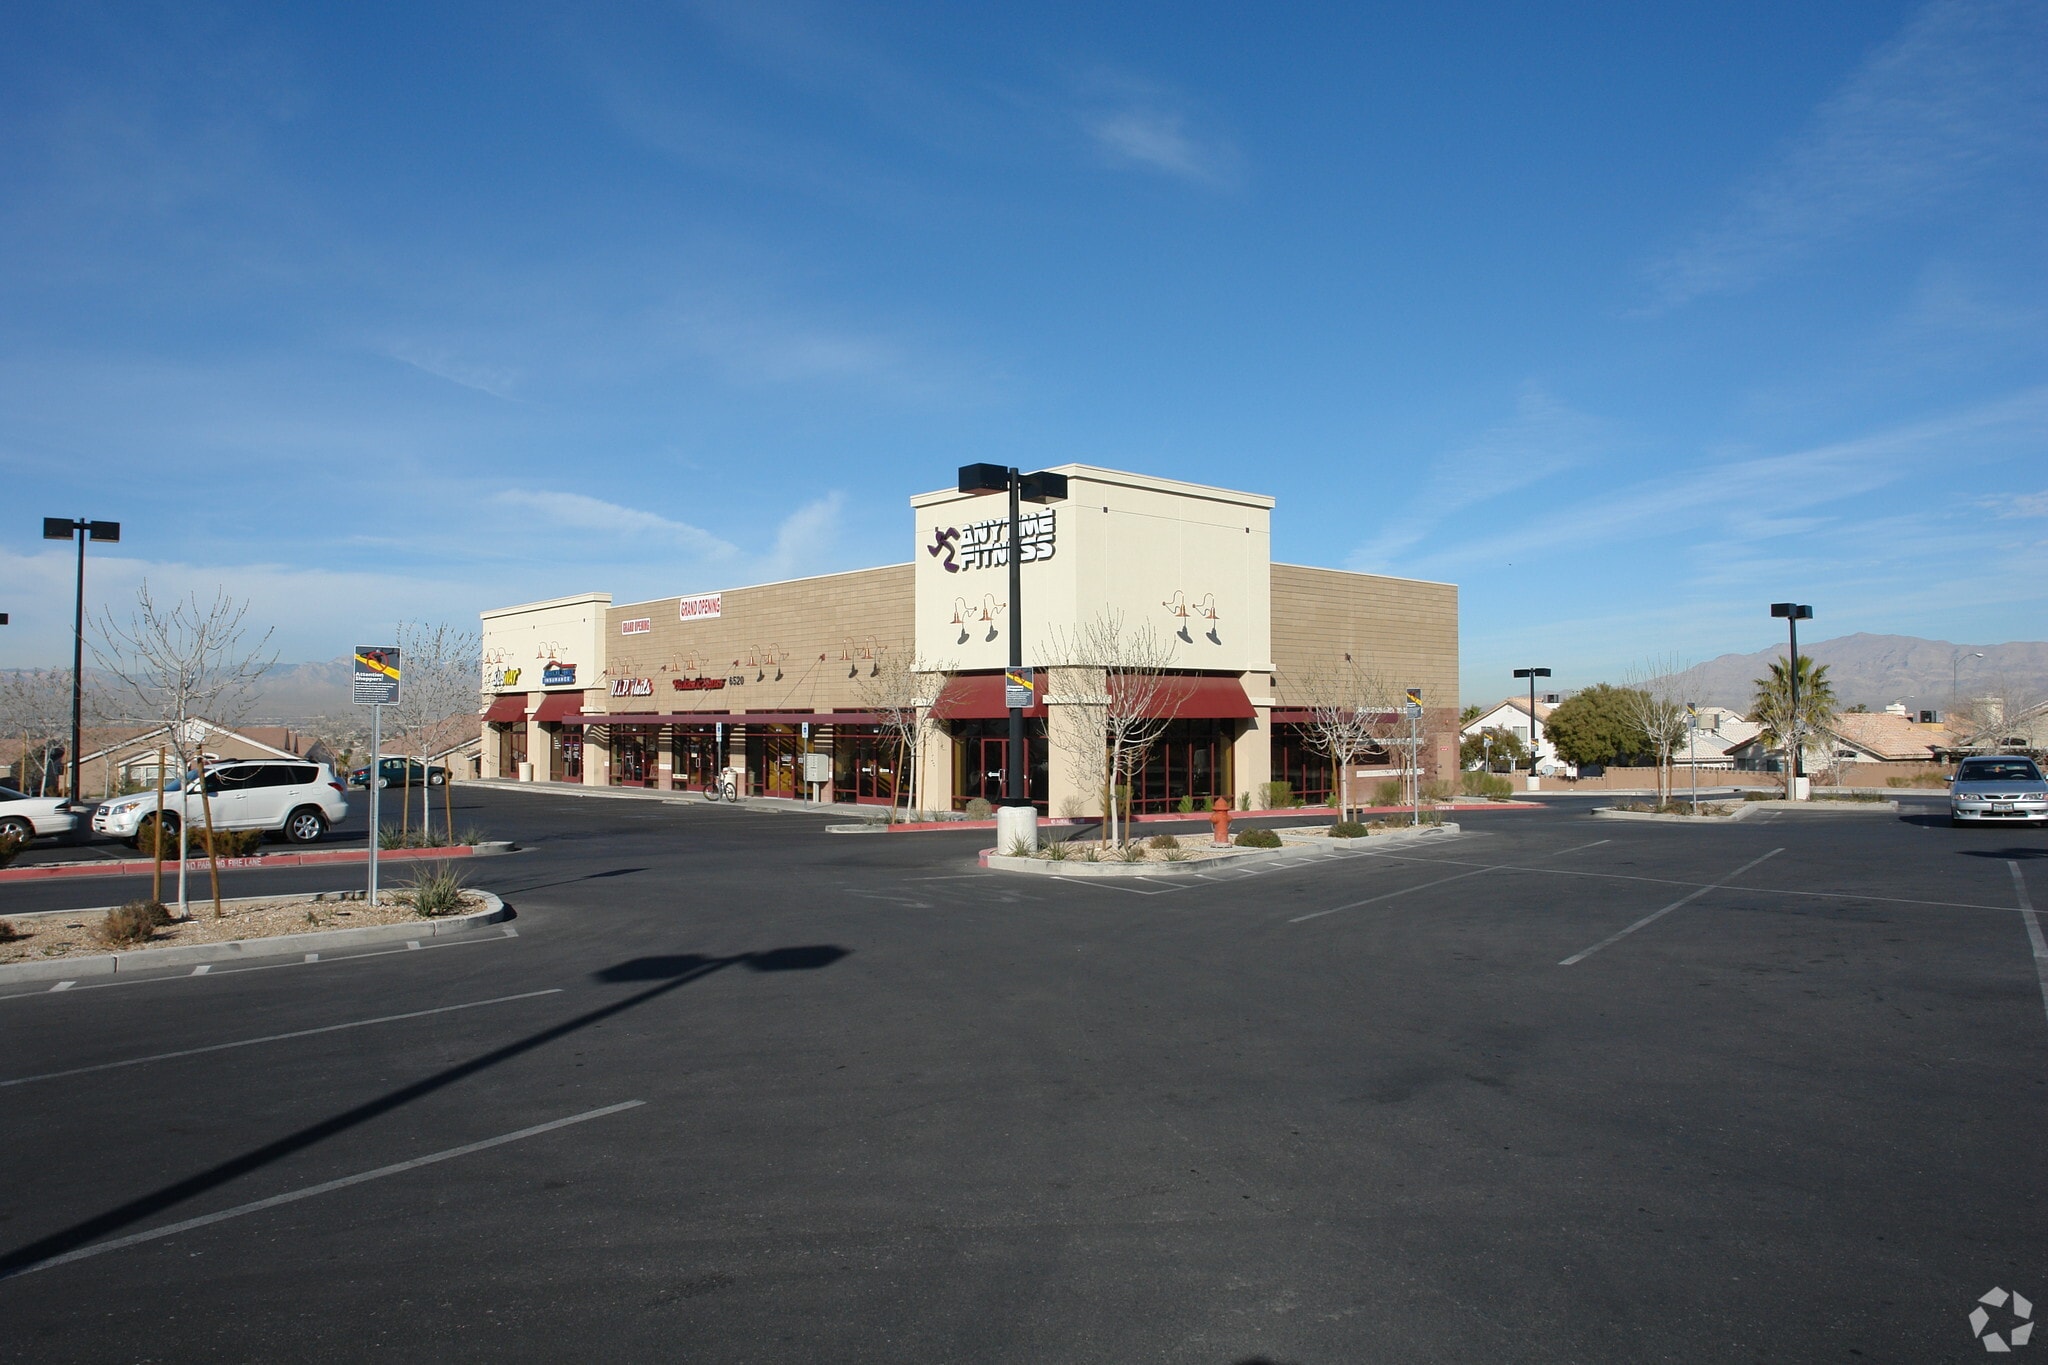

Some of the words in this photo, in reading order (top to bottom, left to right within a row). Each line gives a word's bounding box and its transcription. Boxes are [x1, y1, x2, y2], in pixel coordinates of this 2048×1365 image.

[961, 508, 1054, 546] ANYTME
[961, 533, 1054, 569] FITNSS
[681, 601, 697, 616] GRAND
[698, 597, 720, 614] OPENING
[623, 622, 634, 633] GRAND
[635, 620, 649, 632] OPENING
[729, 676, 744, 686] 6520
[197, 860, 225, 870] PARNG
[228, 859, 243, 867] FIRE
[244, 857, 262, 866] LANE
